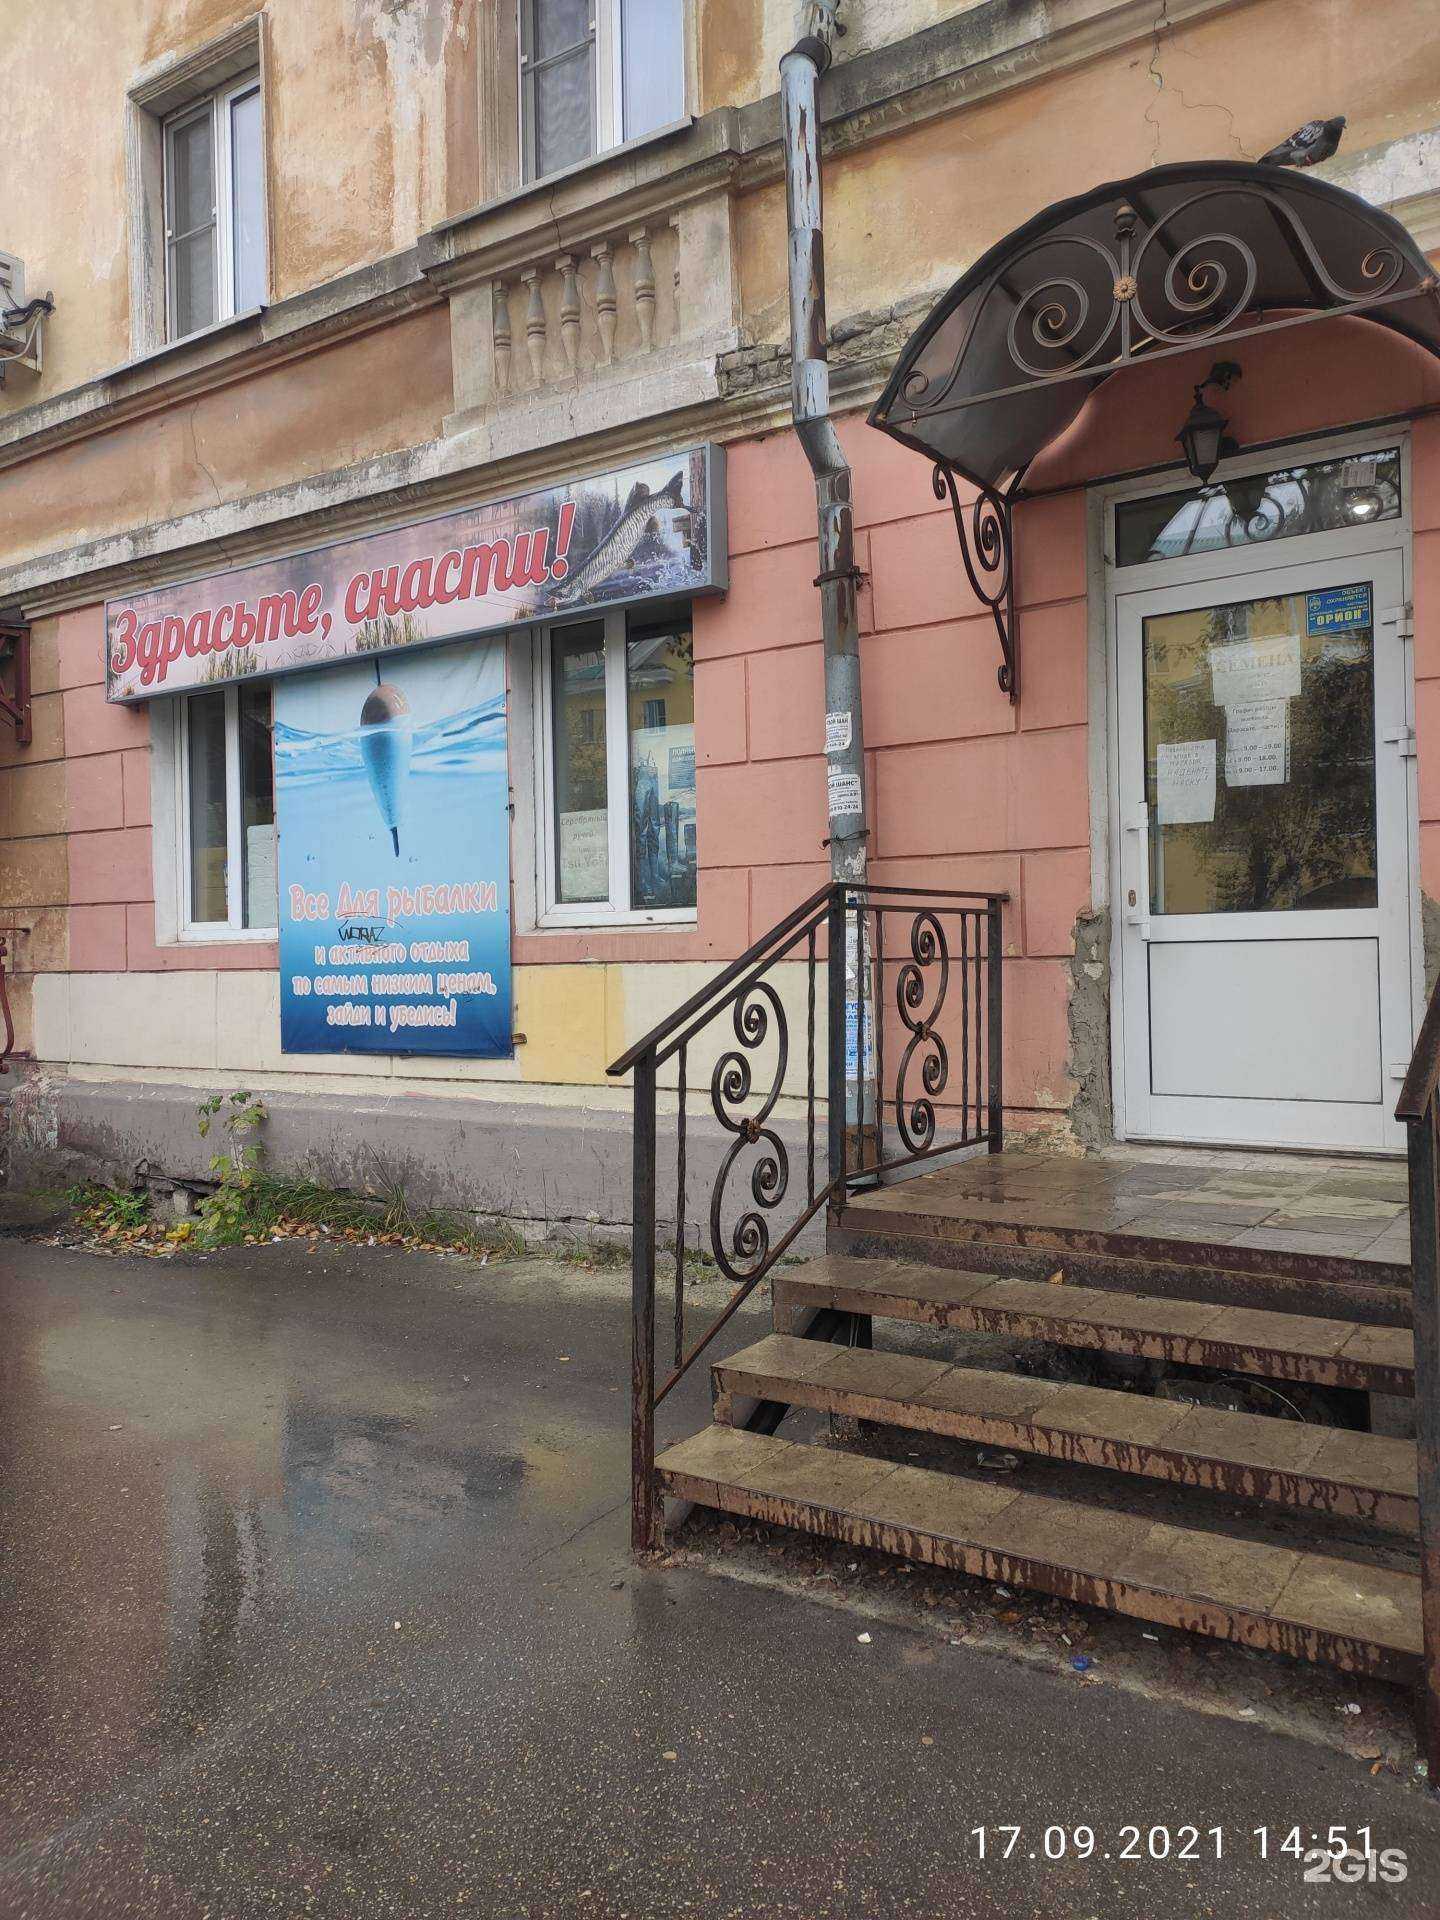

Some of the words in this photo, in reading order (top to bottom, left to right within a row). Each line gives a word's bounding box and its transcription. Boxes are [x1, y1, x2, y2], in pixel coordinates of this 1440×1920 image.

[111, 583, 333, 687] Здрасьте,
[345, 501, 576, 625] снасти!
[289, 883, 329, 921] Все
[335, 881, 381, 920] Для
[386, 880, 498, 927] рыбалки
[315, 946, 326, 965] и
[328, 944, 407, 965] активного
[410, 940, 470, 963] отдыха
[292, 976, 312, 996] по
[314, 974, 369, 996] самым
[371, 972, 434, 996] низким
[436, 971, 498, 999] ценам,
[326, 1001, 371, 1027] зайди
[374, 1004, 387, 1026] и
[389, 997, 457, 1033] убедись!
